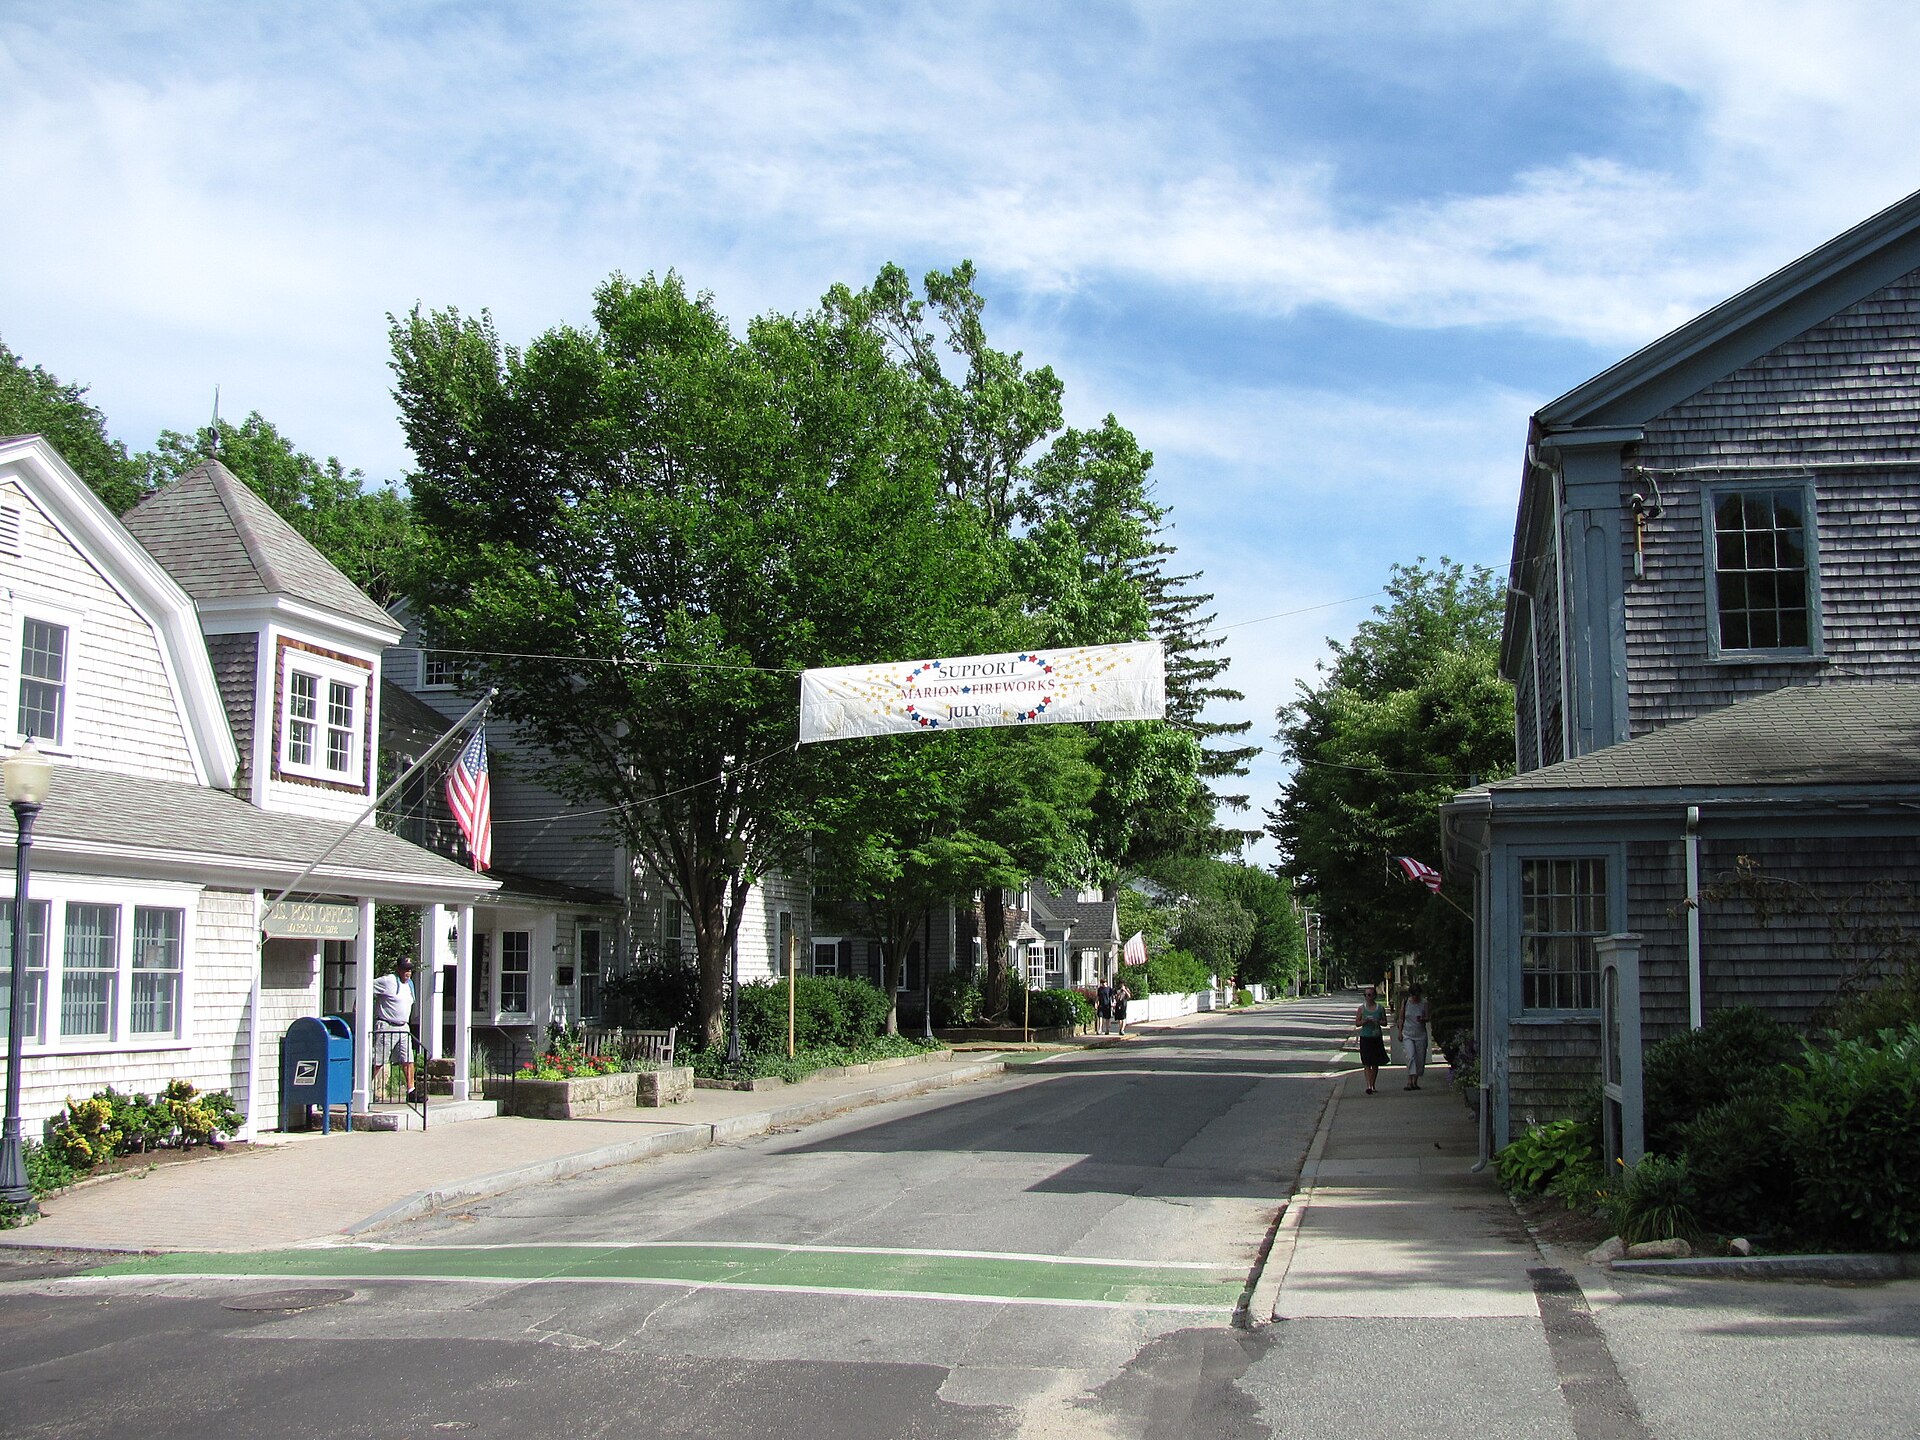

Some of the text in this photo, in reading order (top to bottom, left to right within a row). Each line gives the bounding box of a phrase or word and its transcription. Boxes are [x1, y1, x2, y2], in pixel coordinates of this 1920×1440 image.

[938, 661, 1019, 679] SUPPORT
[900, 679, 1055, 700] MARION FIREWORKS
[948, 703, 1002, 721] JULY 3rd
[291, 904, 317, 922] POST
[319, 906, 354, 924] OFFICE
